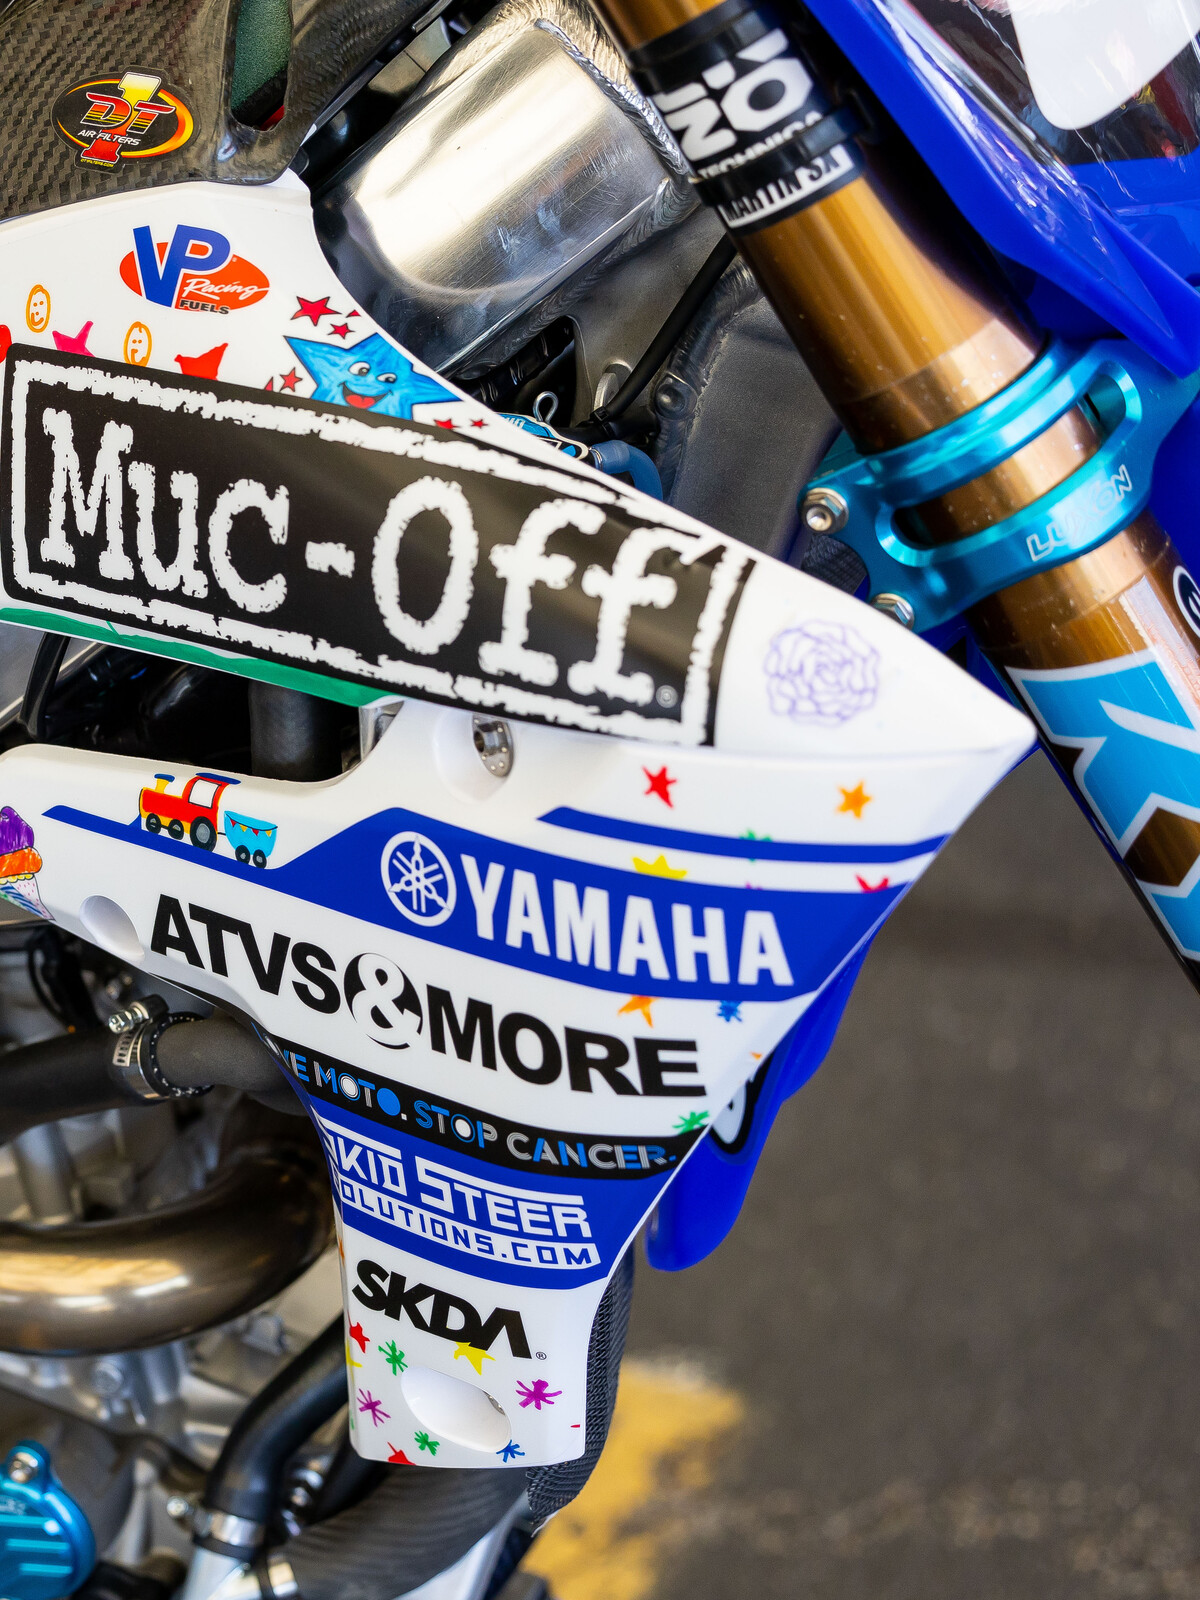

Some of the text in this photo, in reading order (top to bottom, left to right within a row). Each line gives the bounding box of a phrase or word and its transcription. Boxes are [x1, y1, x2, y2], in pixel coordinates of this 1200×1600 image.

[77, 129, 141, 146] AIR FILTERS
[132, 223, 232, 309] VP
[179, 299, 230, 315] FUELS
[182, 277, 270, 301] Racing
[40, 407, 704, 703] Muc-Off
[460, 853, 794, 987] YAMAHA
[414, 1100, 499, 1149] STOP
[414, 1155, 593, 1239] STEER
[351, 1259, 533, 1360] SKDA
